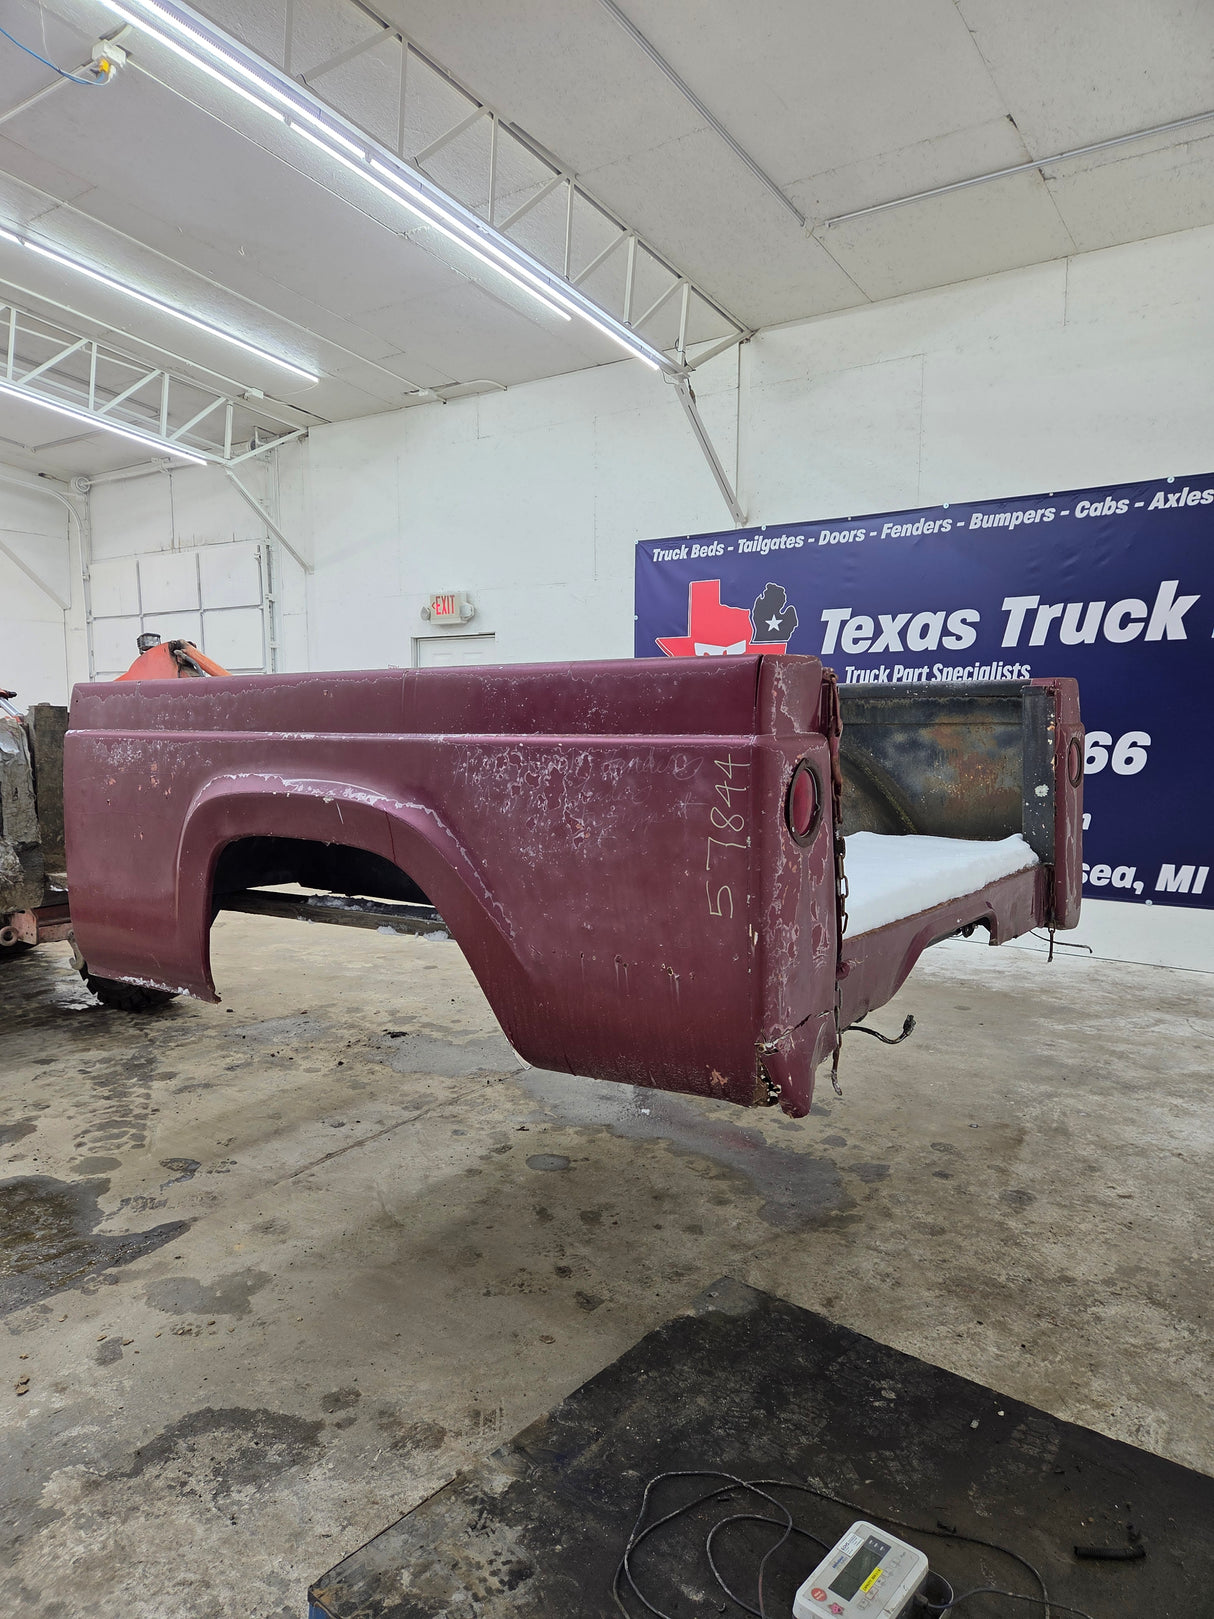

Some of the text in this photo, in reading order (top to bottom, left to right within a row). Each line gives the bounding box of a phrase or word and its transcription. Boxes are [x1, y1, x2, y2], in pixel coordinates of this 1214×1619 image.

[652, 545, 688, 562] Truck
[691, 541, 724, 559] Beds
[737, 533, 804, 556] Tailgates
[818, 526, 865, 546] Doors
[881, 517, 952, 539] Fenders
[969, 506, 1056, 530] Bumpers
[1075, 496, 1129, 518] Cabs
[1148, 487, 1214, 511] Axles
[435, 594, 455, 615] EXIT
[820, 580, 1201, 655] Texas Truck
[845, 661, 1031, 684] Truck Part Specialists
[706, 753, 750, 919] 57844
[1155, 863, 1210, 895] MI
